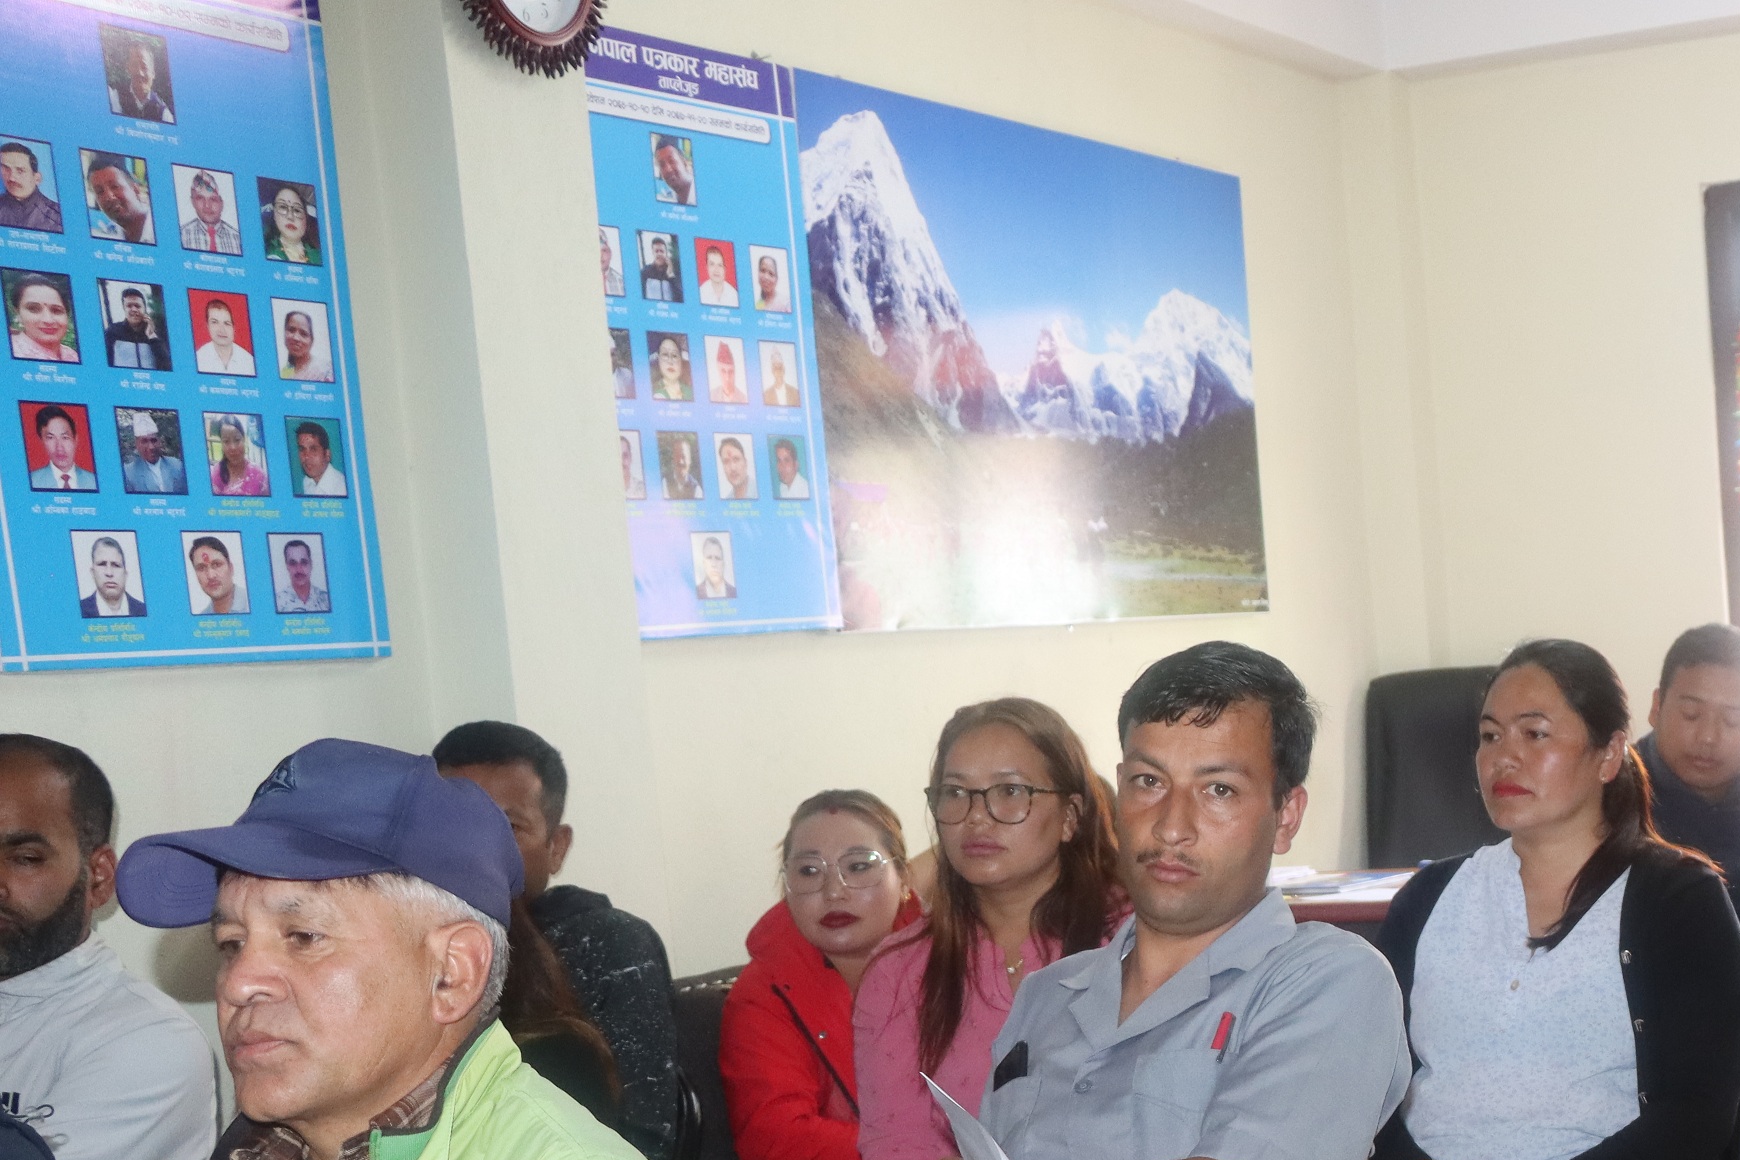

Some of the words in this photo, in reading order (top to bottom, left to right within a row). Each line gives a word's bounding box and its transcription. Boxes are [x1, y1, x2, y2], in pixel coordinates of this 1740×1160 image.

[588, 37, 637, 64] नपाल
[641, 45, 700, 78] पत्रकार
[703, 58, 759, 90] महासंघ
[657, 74, 701, 97] ताप्लेजुङ
